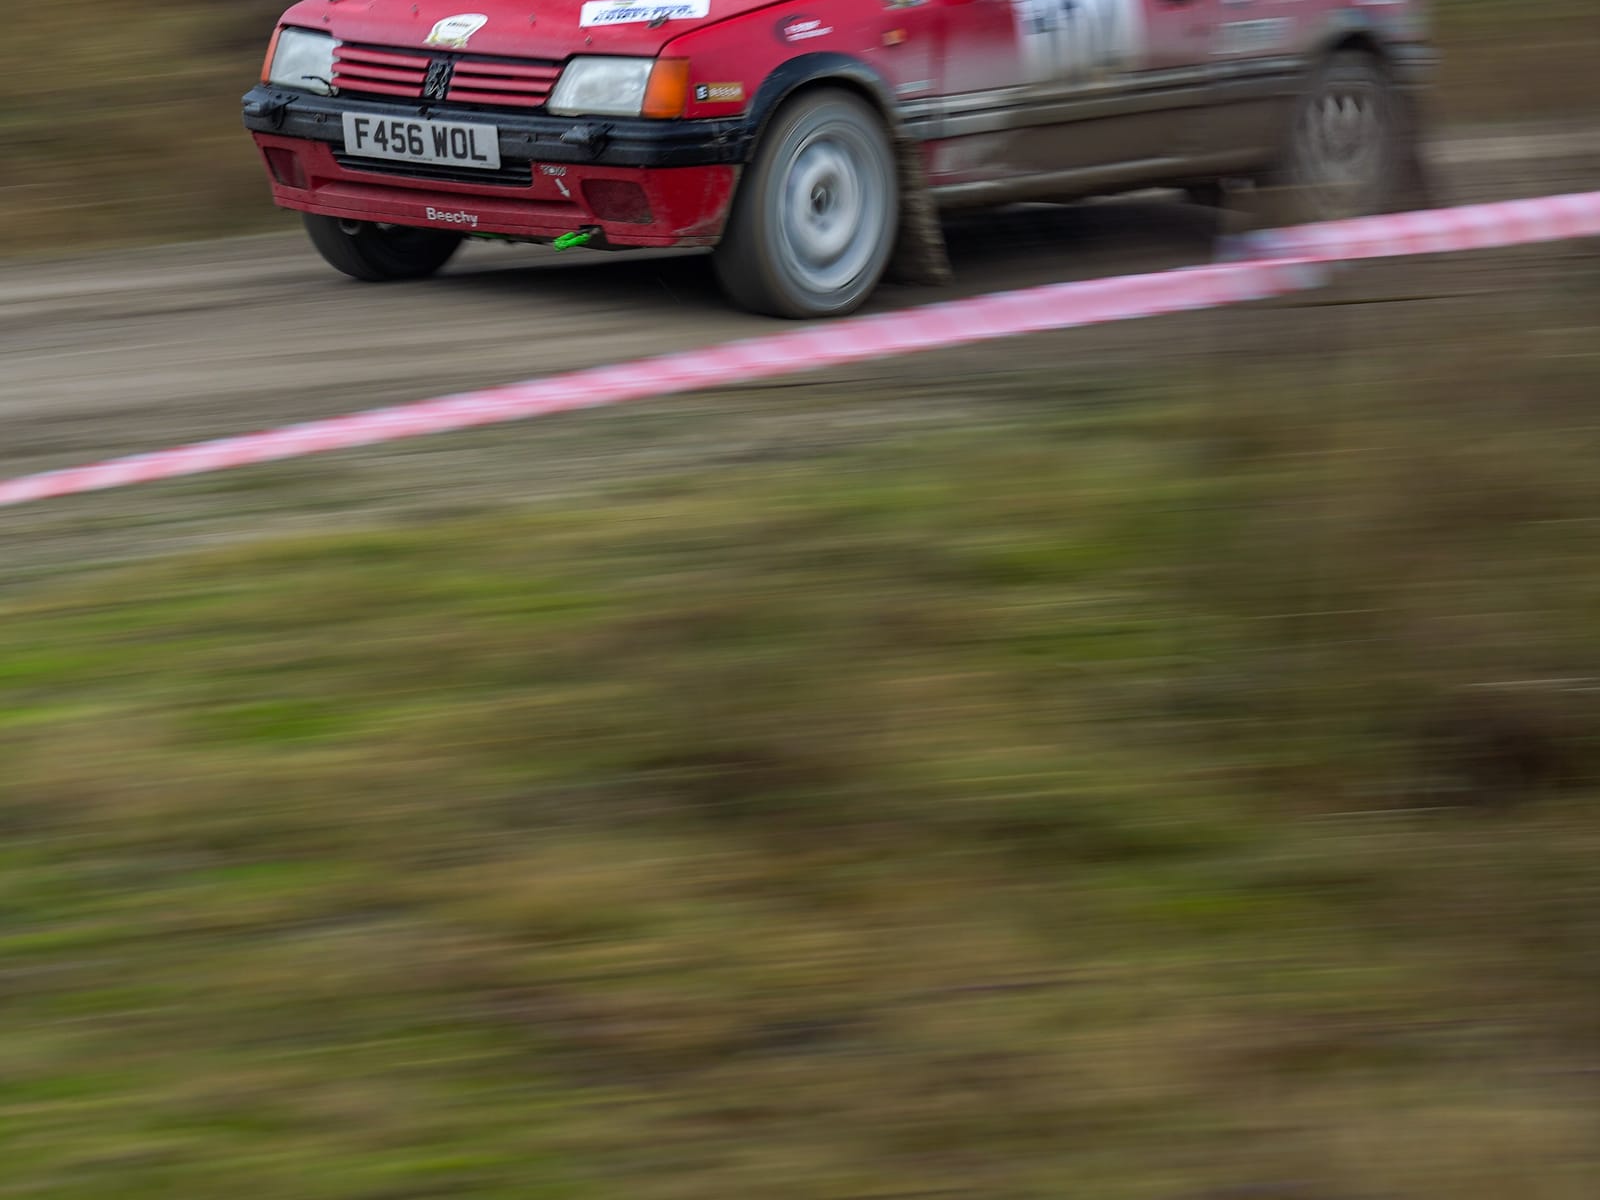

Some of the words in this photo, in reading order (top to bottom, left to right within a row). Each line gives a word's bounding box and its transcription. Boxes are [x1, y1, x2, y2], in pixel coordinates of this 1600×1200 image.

[354, 117, 425, 156] F456
[431, 125, 488, 162] WOL
[540, 164, 567, 177] TOW
[425, 206, 478, 228] Beechy
